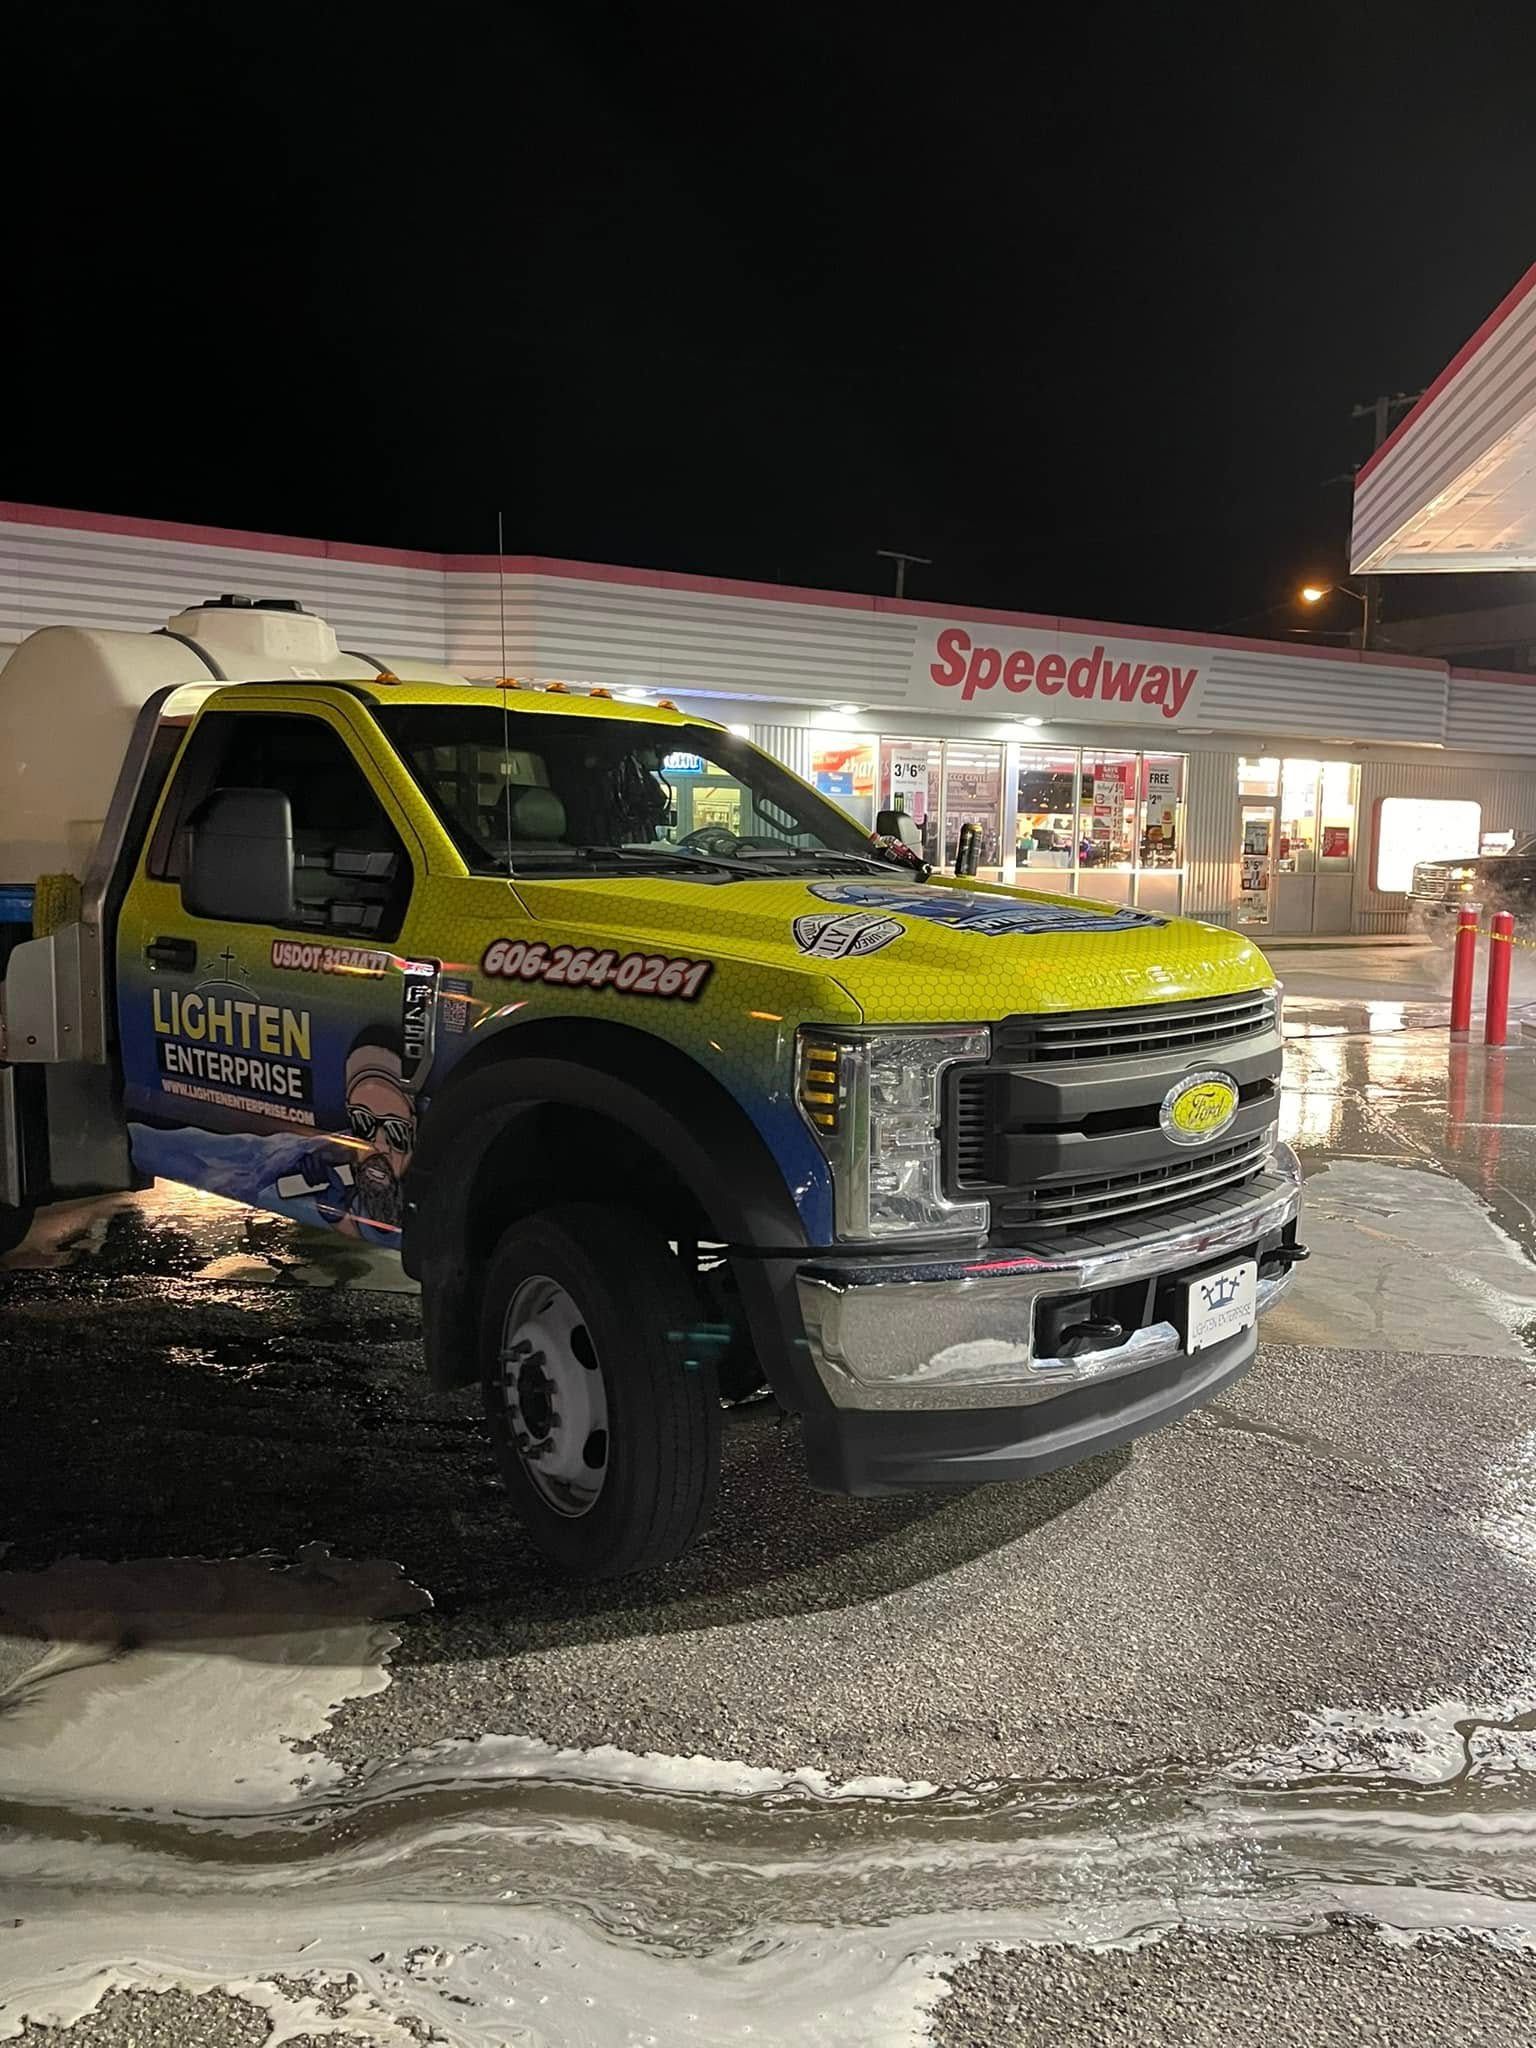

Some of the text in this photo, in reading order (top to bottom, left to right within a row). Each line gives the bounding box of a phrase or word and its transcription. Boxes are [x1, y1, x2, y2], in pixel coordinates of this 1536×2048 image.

[930, 628, 1198, 718] Speedway
[1149, 773, 1169, 784] FREE
[272, 942, 322, 972] USDOT
[484, 940, 710, 998] 606-264-0261
[152, 988, 312, 1060] LIGHTEN
[164, 1043, 304, 1099] ENTERPRISE
[161, 1078, 316, 1127] WWW.LIGHTENENTERPRISE.COM
[1187, 1092, 1226, 1126] Ford
